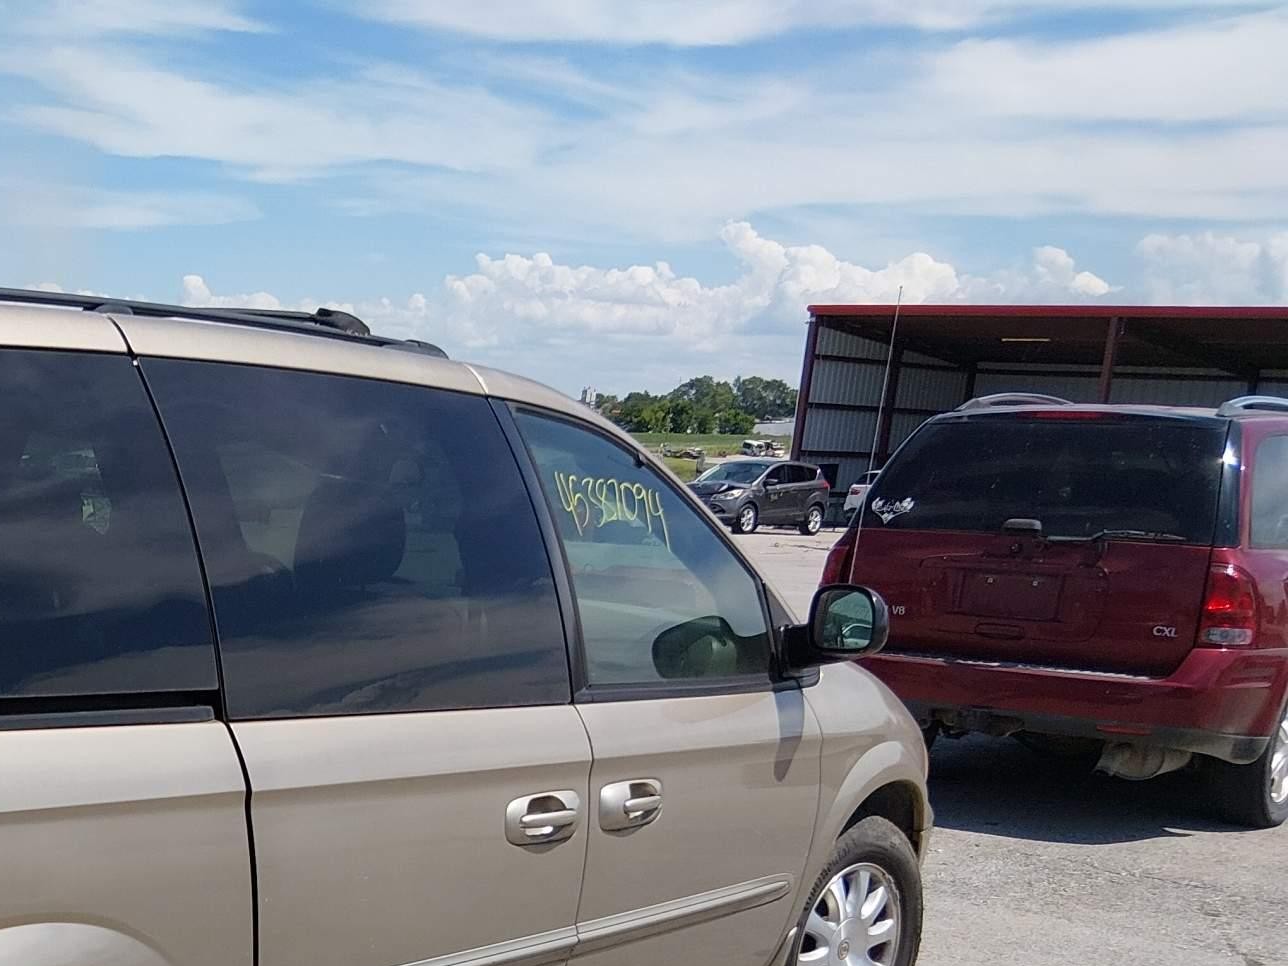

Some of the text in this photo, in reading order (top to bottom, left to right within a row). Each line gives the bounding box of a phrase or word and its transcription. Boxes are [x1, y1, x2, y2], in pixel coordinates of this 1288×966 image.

[554, 471, 671, 552] 45387094
[892, 605, 905, 616] V8
[1152, 625, 1177, 638] CXL
